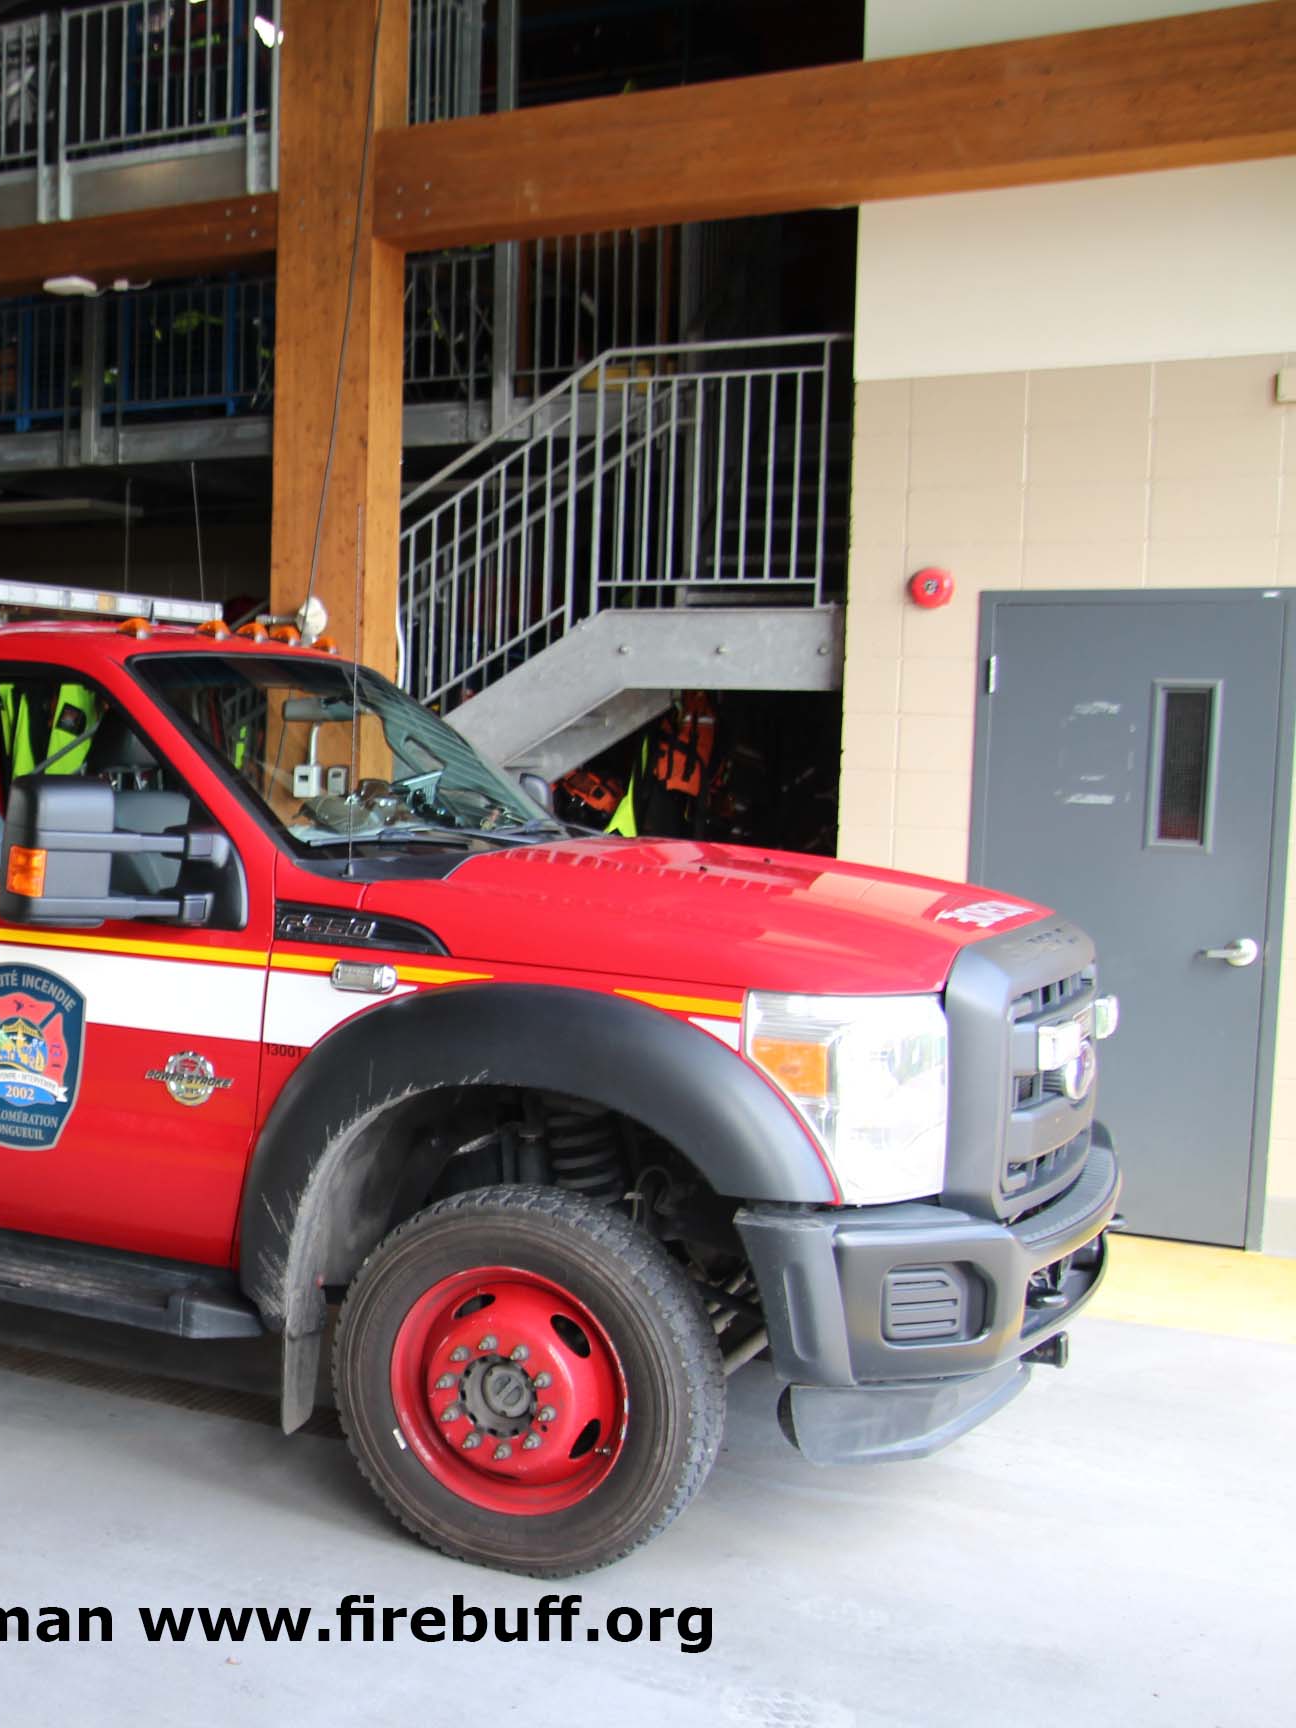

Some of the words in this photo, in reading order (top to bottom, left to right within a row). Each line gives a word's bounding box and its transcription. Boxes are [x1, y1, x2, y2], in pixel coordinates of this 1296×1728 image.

[21, 974, 77, 1013] INCENDIE
[265, 1042, 302, 1059] 13001
[5, 1084, 35, 1100] 2002
